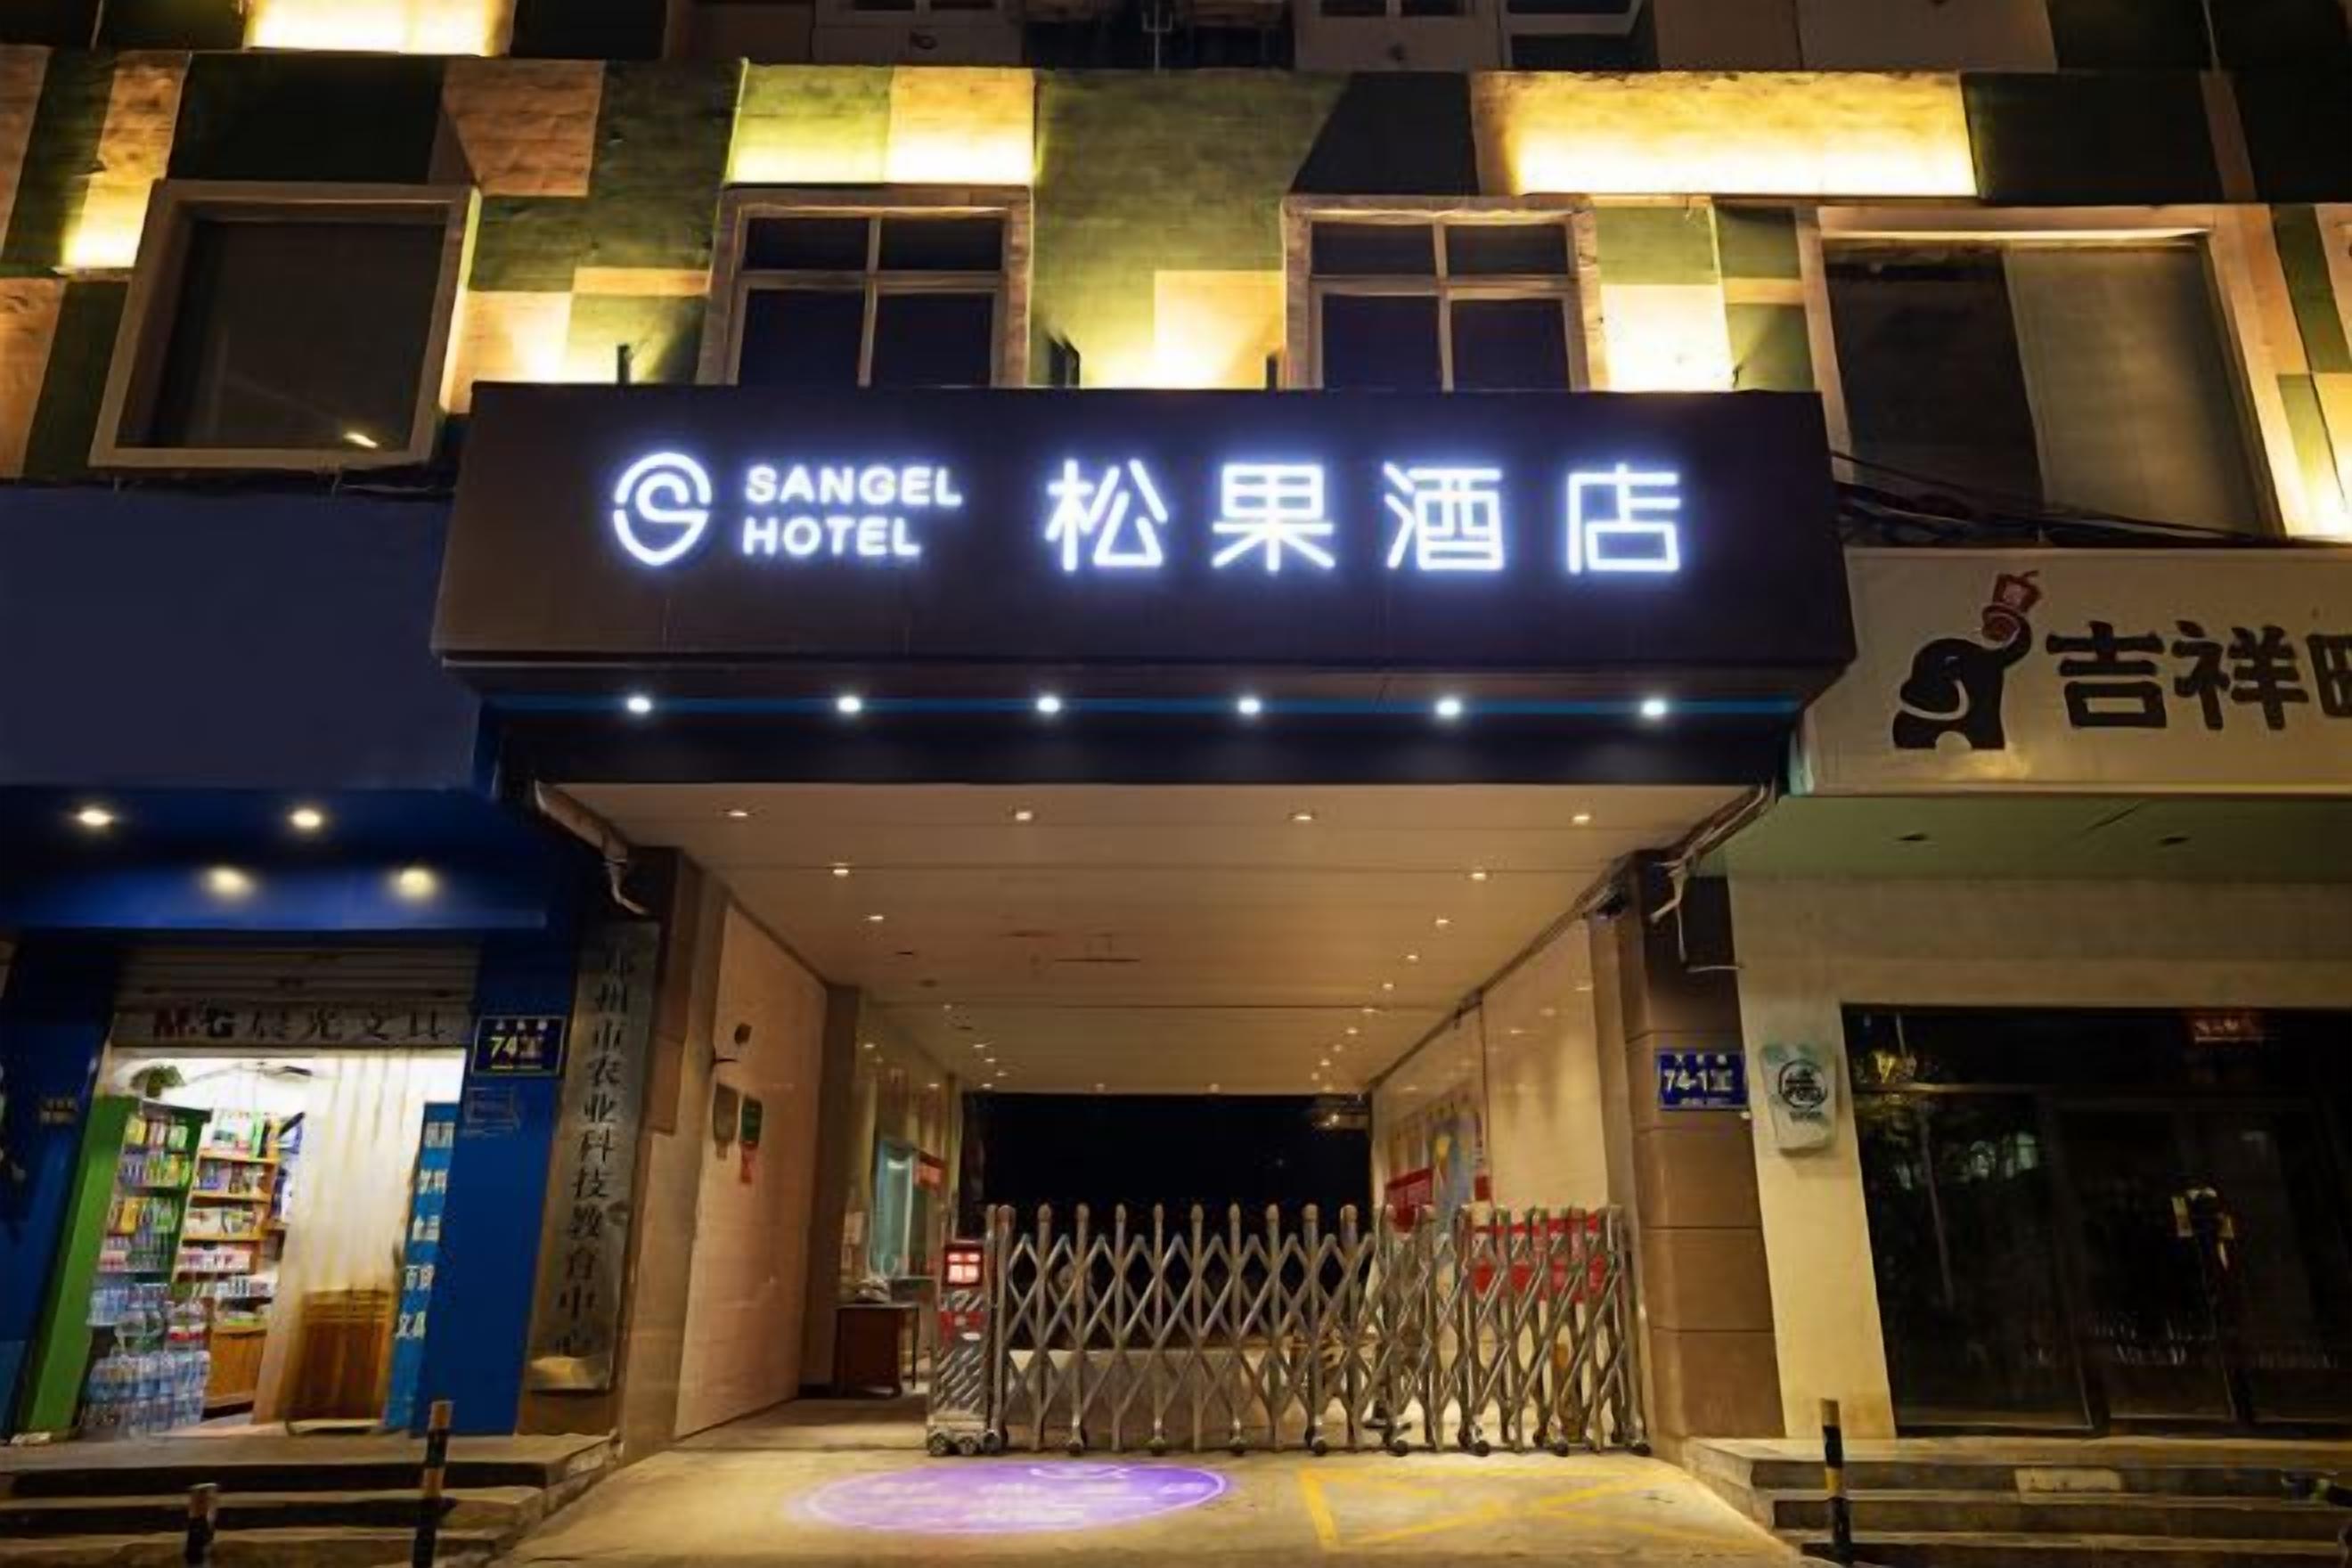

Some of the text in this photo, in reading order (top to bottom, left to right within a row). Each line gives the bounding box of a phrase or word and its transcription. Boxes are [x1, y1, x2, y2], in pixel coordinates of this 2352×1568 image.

[745, 464, 963, 507] SANGEL
[742, 515, 921, 556] HOTEL
[1044, 459, 1681, 575] 松果酒店
